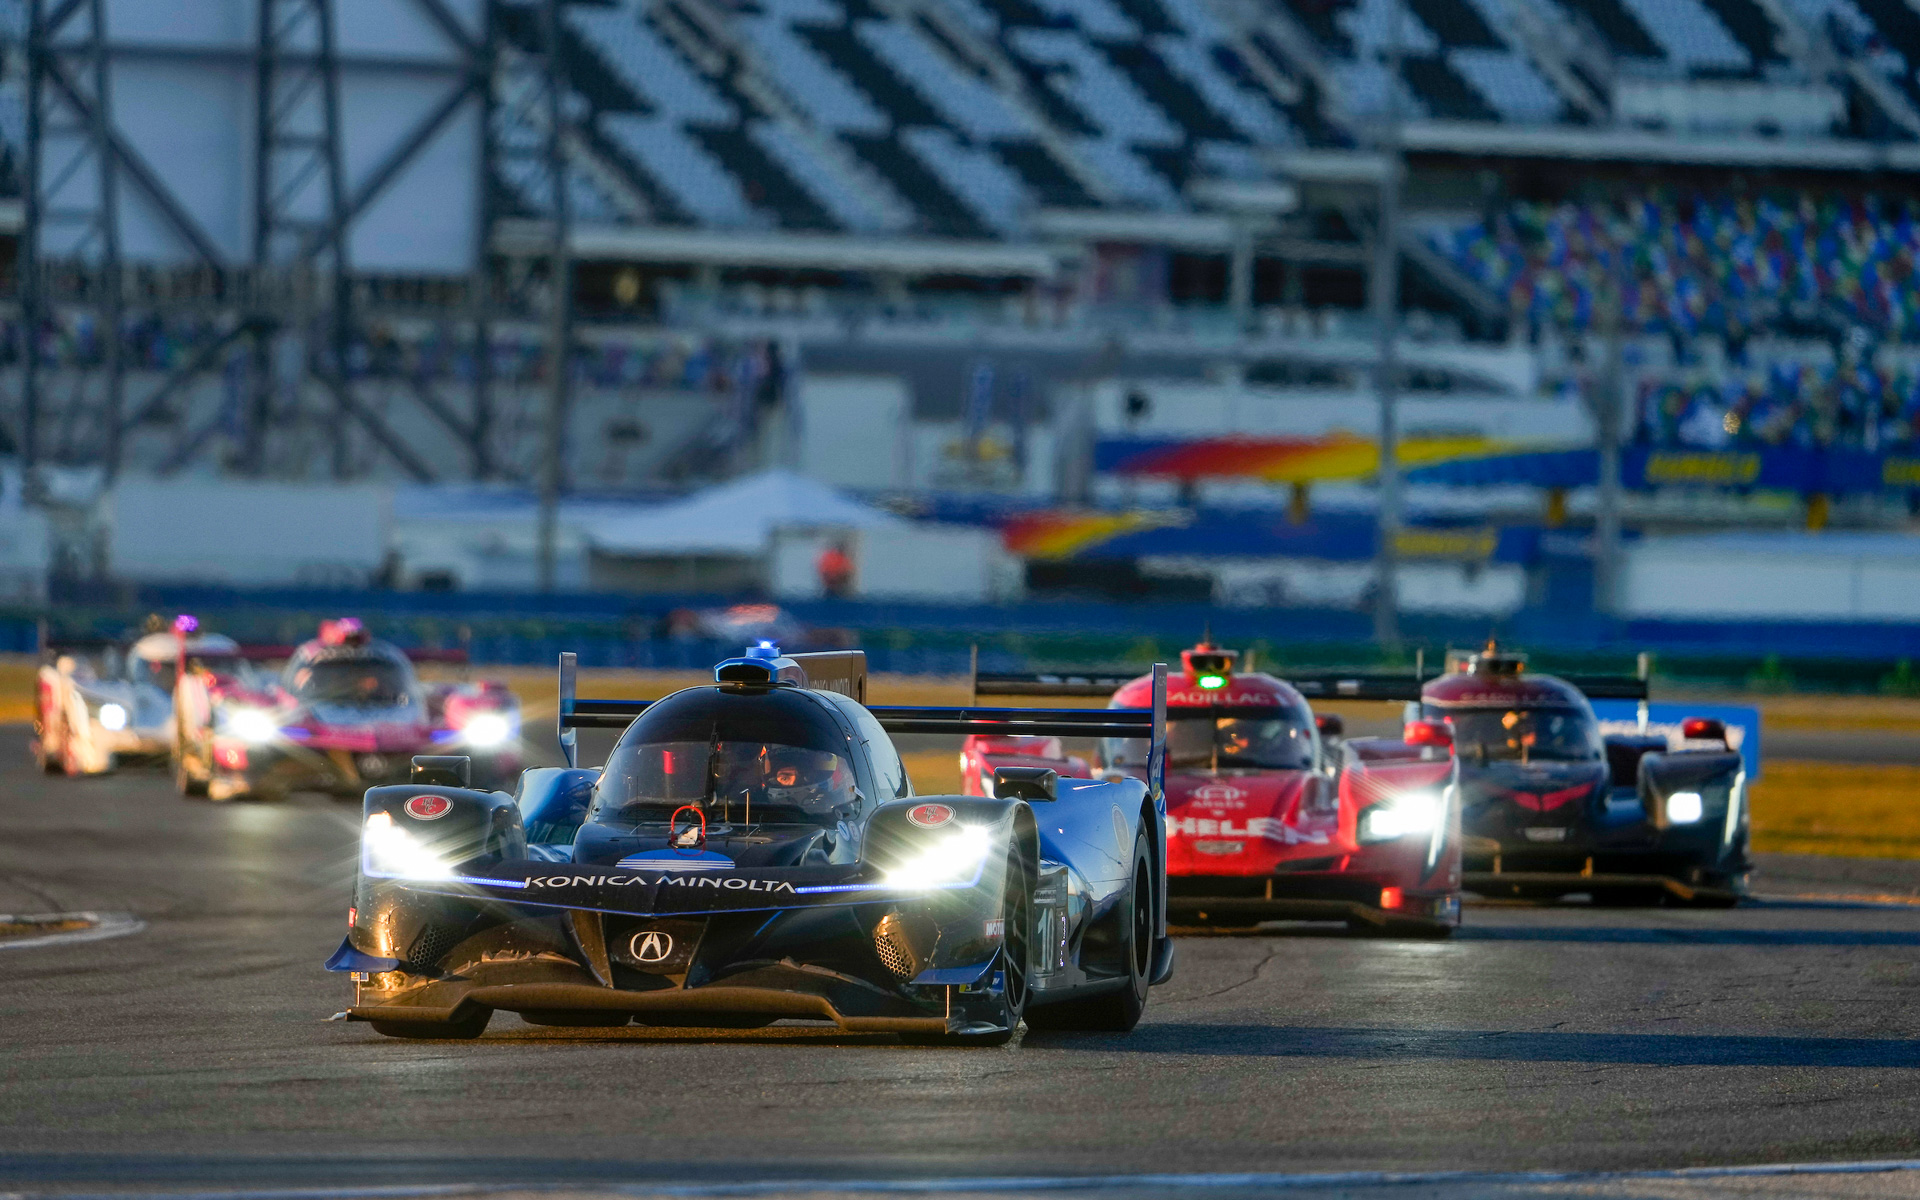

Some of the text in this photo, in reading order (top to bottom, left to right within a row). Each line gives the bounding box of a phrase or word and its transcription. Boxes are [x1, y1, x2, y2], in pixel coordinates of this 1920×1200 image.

[1166, 814, 1329, 845] HELEN
[523, 875, 797, 893] KONICA MINOLTA
[986, 922, 1004, 936] MOTU
[1037, 907, 1056, 972] 10
